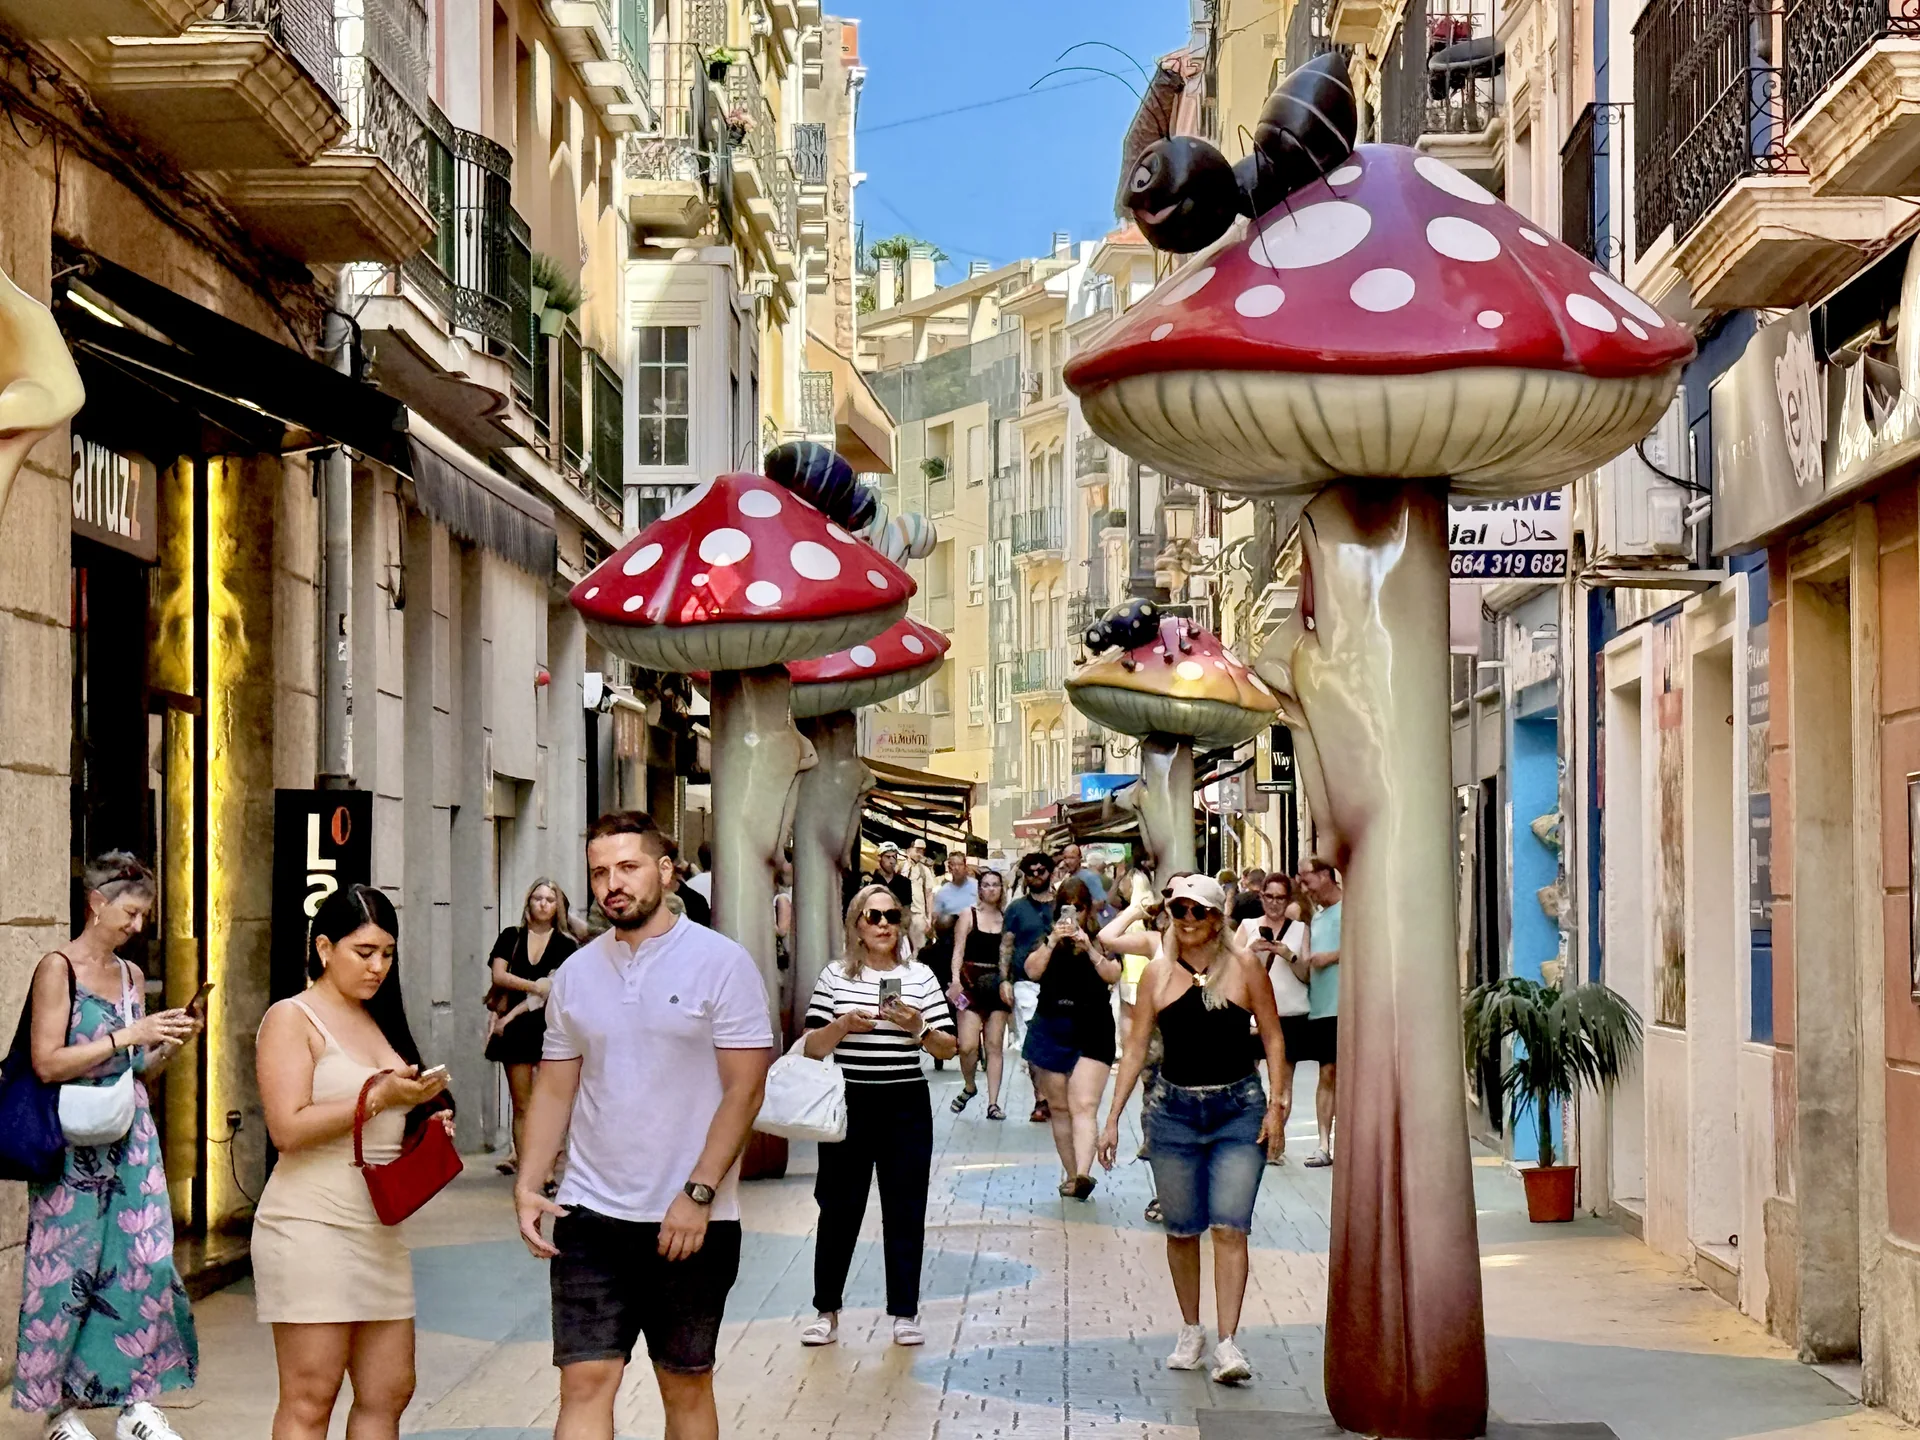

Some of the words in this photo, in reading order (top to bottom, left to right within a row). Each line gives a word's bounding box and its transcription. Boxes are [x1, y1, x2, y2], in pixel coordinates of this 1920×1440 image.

[72, 434, 141, 540] arruzz
[1500, 518, 1558, 547] حلال
[1450, 553, 1486, 575] 664
[1490, 553, 1526, 575] 319
[1530, 553, 1566, 575] 682
[1272, 751, 1291, 771] Way
